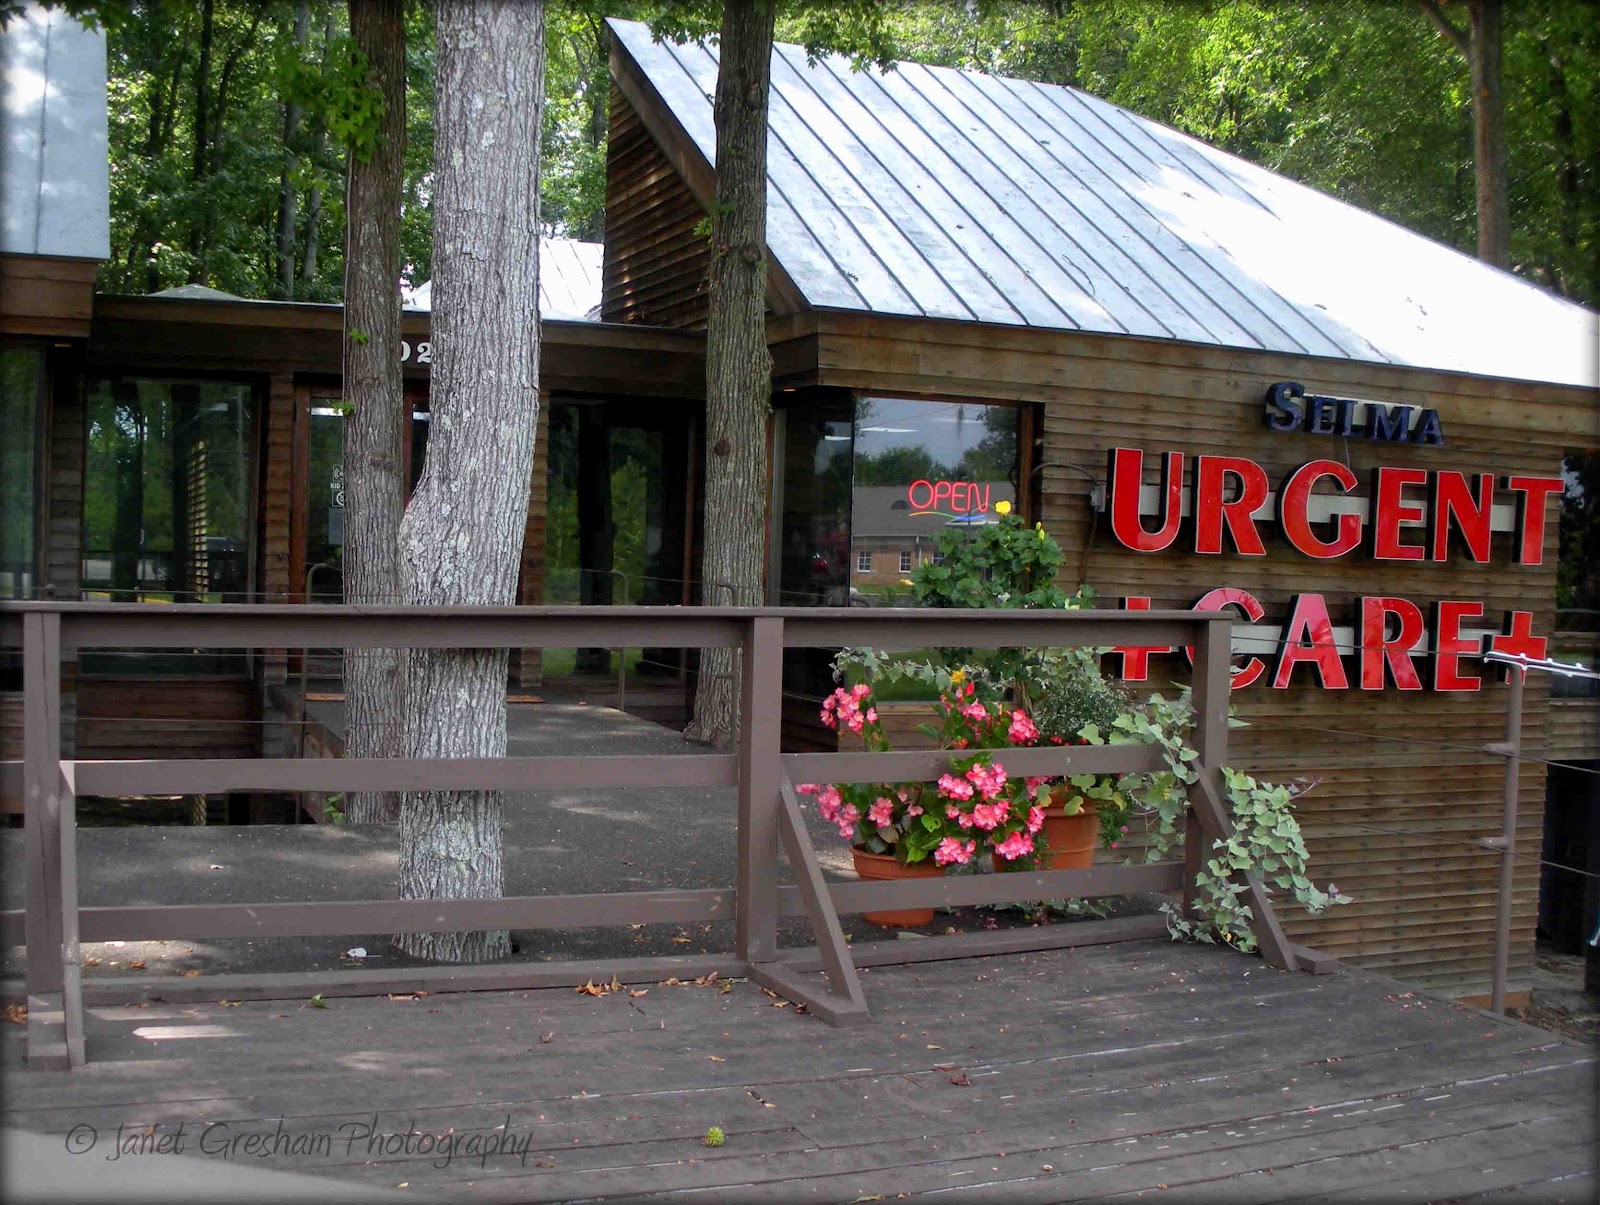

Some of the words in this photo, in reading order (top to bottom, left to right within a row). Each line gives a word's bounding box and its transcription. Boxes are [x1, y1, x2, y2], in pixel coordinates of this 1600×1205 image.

[1264, 381, 1446, 446] SELMA
[908, 479, 990, 513] OPEN
[1108, 447, 1565, 566] URGENT
